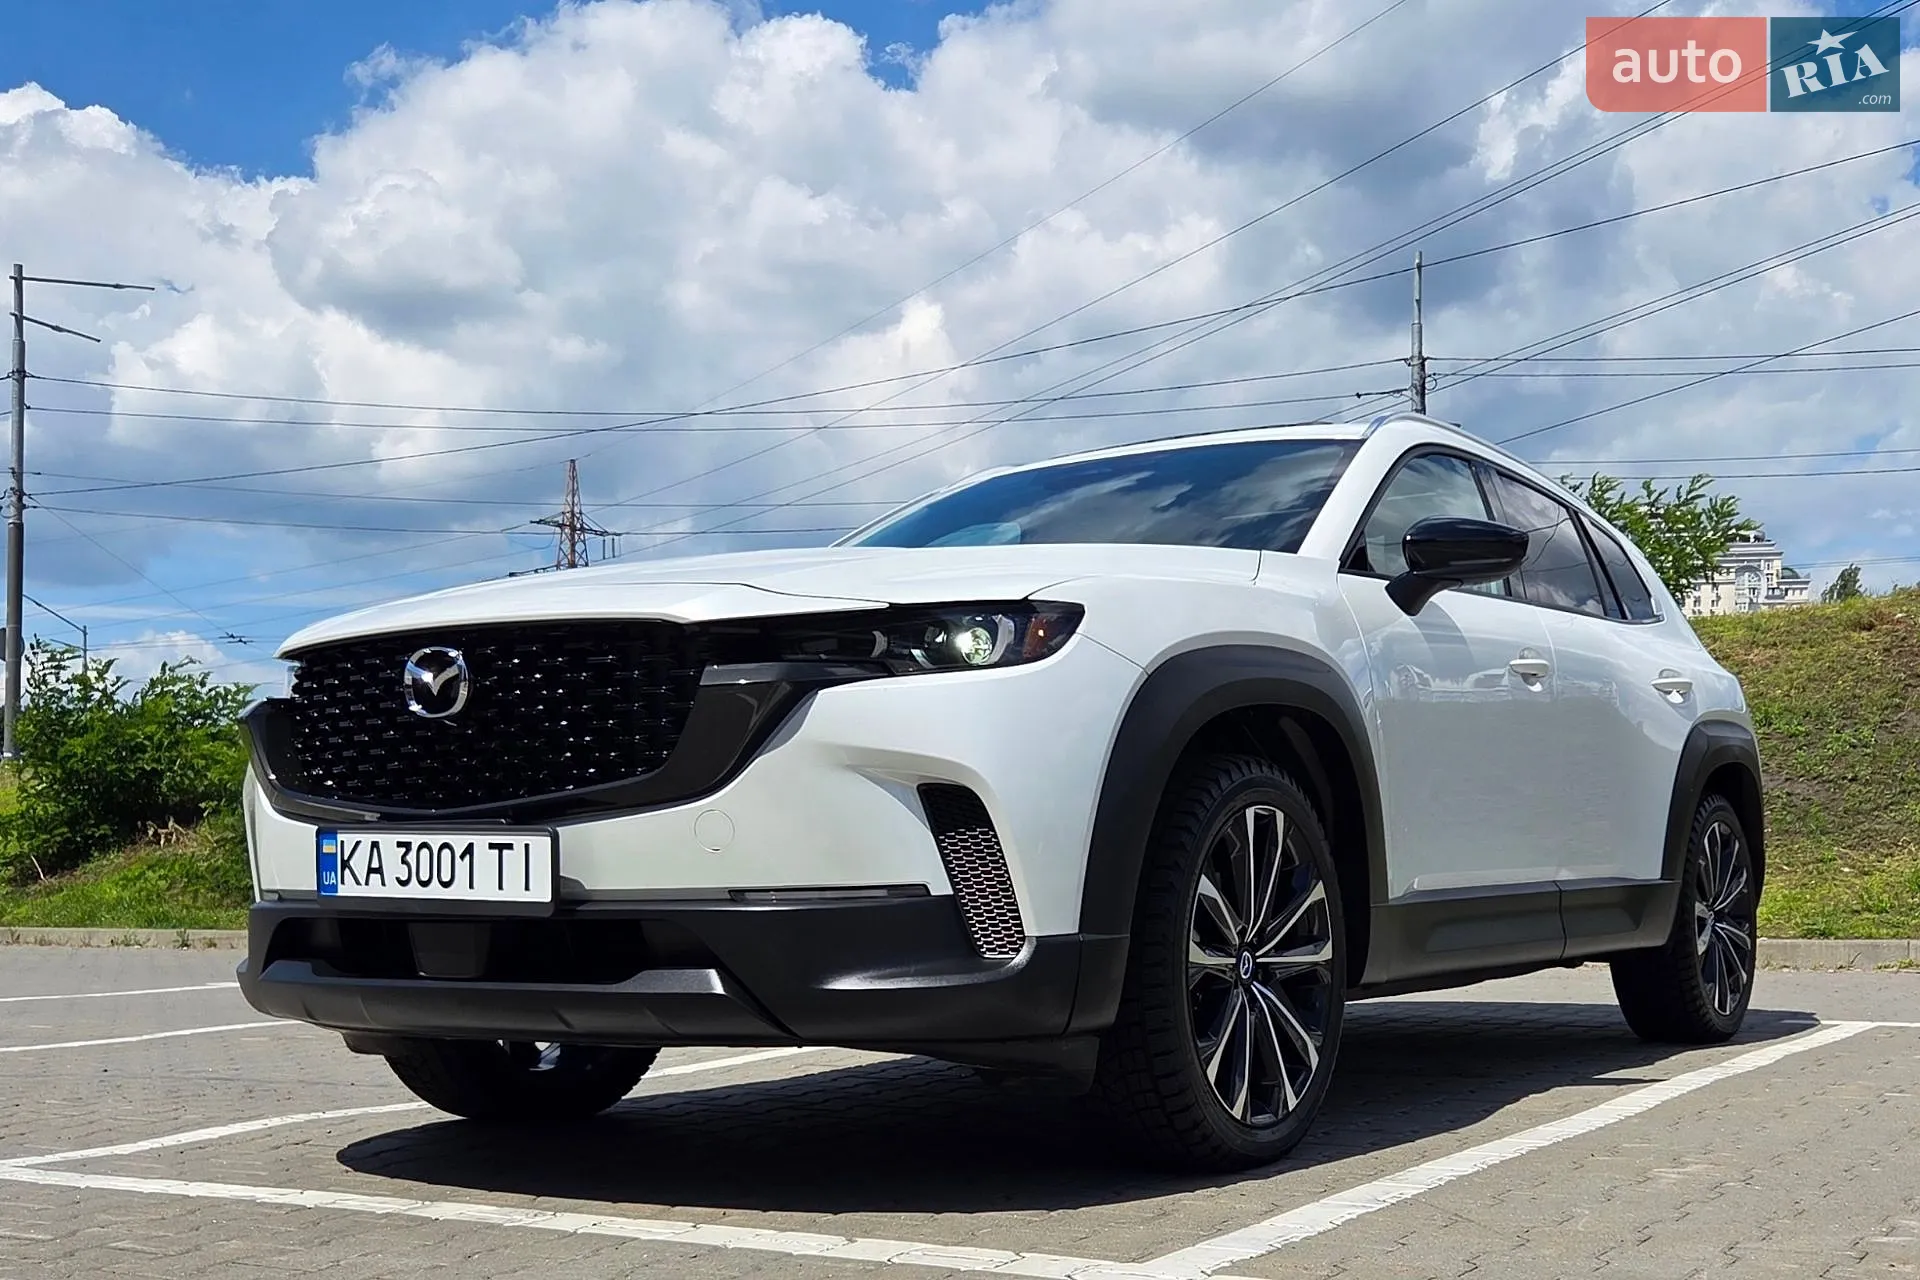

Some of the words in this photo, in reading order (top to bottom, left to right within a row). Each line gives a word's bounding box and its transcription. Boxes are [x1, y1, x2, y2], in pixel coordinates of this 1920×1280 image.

[322, 871, 337, 886] UA
[340, 839, 387, 887] KA
[395, 841, 475, 890] 3001
[488, 842, 531, 891] TI
